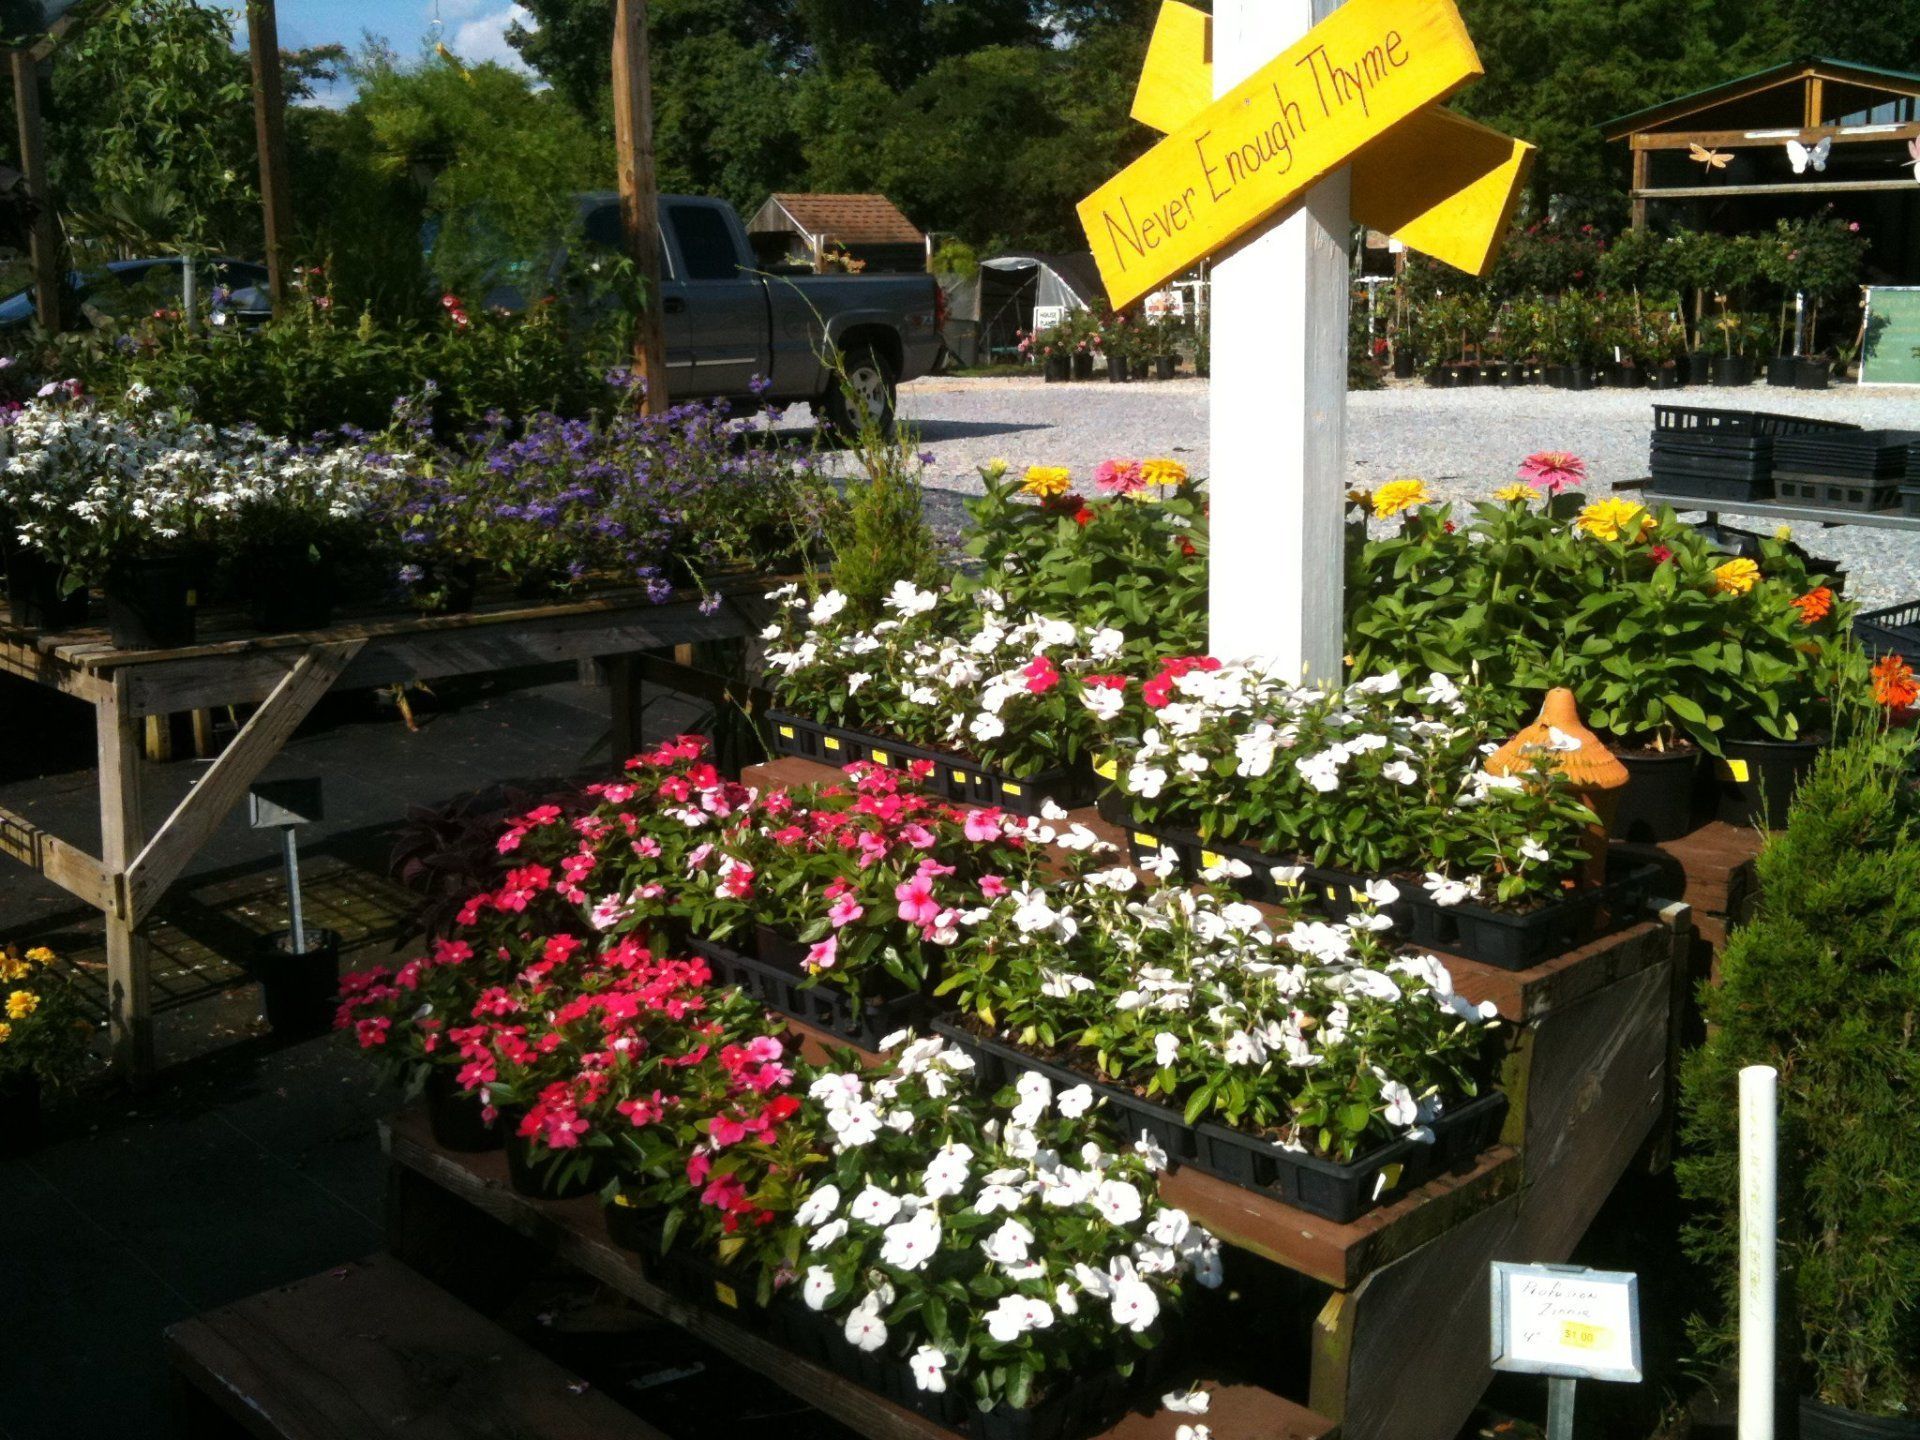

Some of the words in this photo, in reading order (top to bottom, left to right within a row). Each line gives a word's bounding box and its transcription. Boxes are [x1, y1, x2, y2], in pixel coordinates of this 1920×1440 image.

[1103, 186, 1196, 273] Never
[1195, 83, 1307, 203] Enough
[1295, 30, 1409, 118] Thyme
